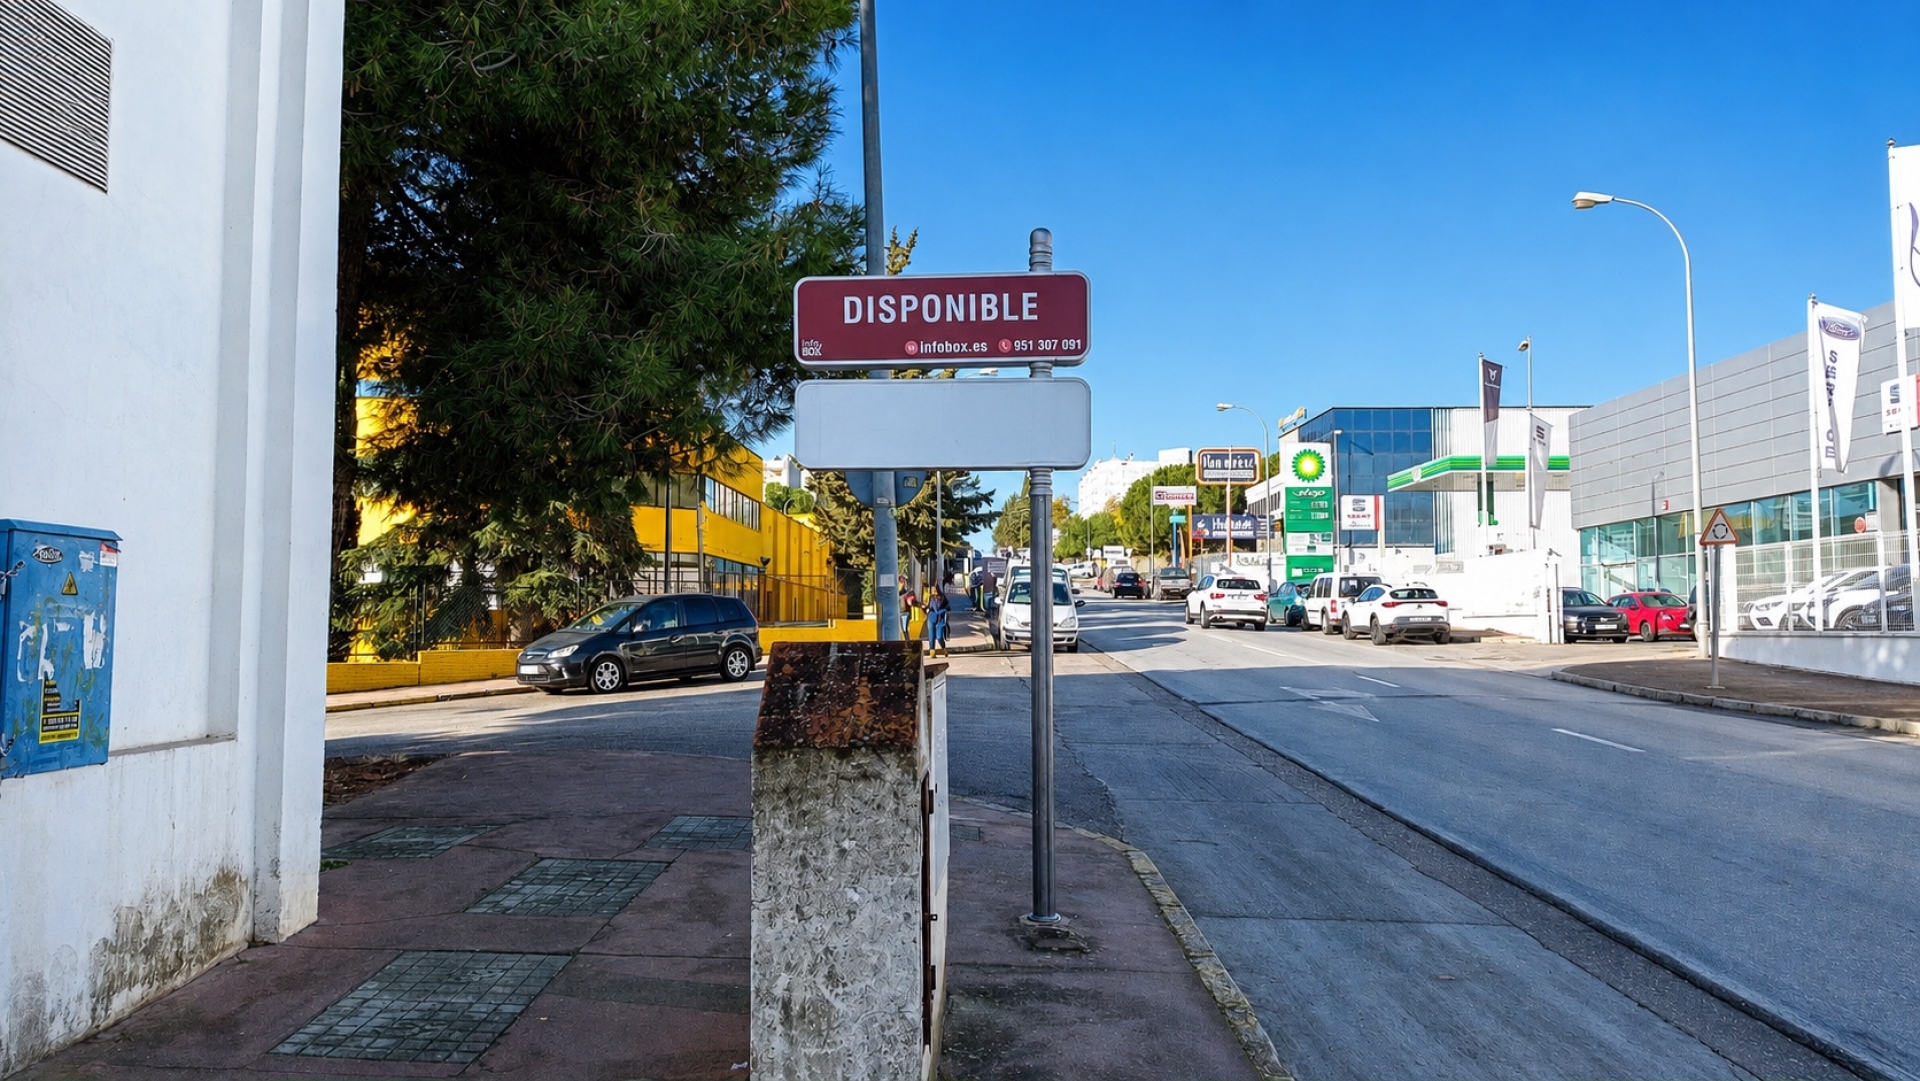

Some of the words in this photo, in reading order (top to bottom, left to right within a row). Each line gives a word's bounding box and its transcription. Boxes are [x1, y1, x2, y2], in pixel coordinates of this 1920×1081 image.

[843, 292, 1038, 324] DISPONIBLE
[920, 340, 988, 354] infobox.es
[1014, 339, 1034, 351] 951
[1037, 338, 1059, 350] 307
[1061, 338, 1082, 350] 091
